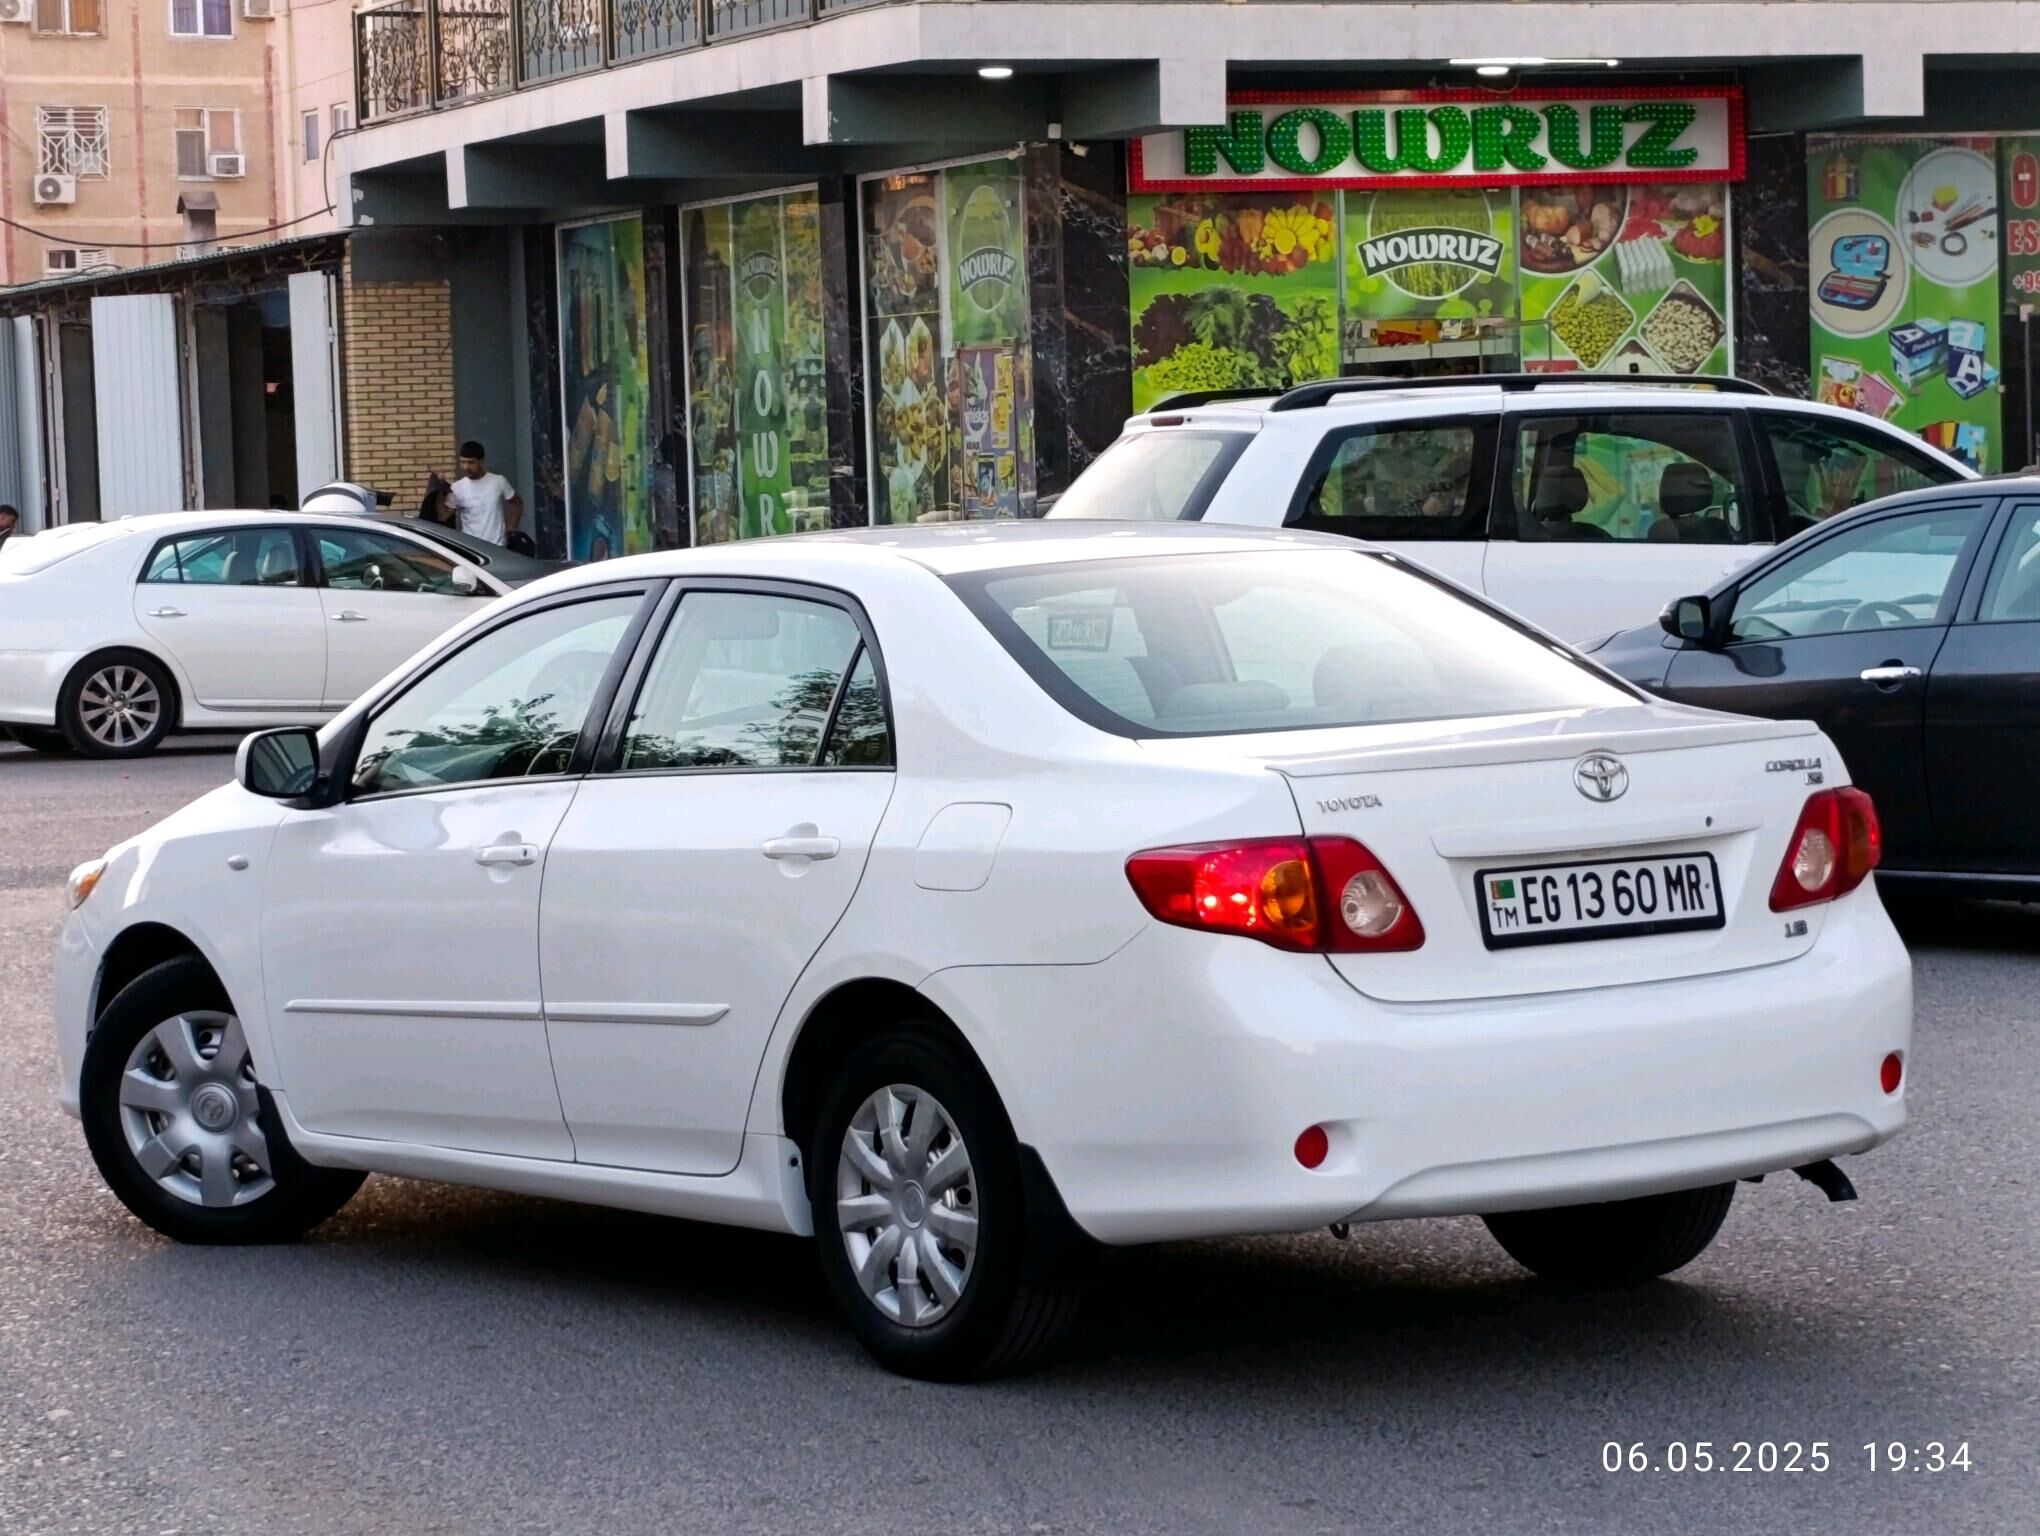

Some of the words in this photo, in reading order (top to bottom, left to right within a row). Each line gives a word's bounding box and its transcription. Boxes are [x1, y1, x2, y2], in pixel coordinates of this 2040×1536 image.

[1183, 103, 1699, 175] NOWRUZ
[1363, 234, 1500, 268] NOWRUZ
[2008, 219, 2040, 256] ES
[1316, 795, 1383, 813] TOYOTA
[1521, 875, 1561, 924] EG
[1566, 872, 1605, 919] 13
[1612, 867, 1657, 916] 60
[1663, 864, 1705, 912] MR
[1493, 906, 1519, 928] TM
